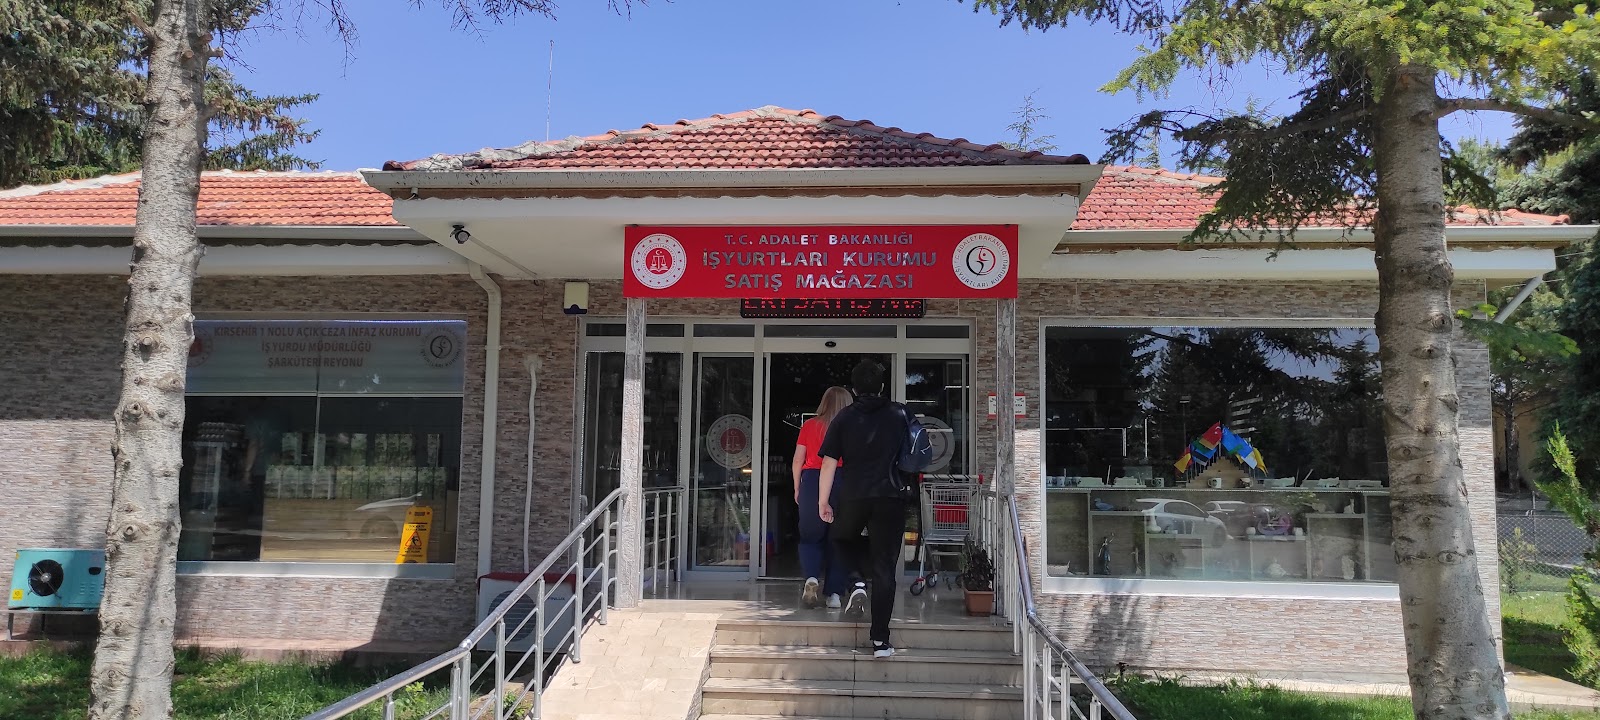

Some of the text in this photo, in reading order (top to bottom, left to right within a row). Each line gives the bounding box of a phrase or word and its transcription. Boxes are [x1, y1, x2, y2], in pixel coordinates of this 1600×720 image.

[759, 234, 818, 245] ADALET
[828, 232, 913, 245] BAKANLIĞI
[702, 248, 937, 269] İŞYURTLARI KURUMU
[724, 269, 913, 292] SATIŞ MAĞAZASI
[260, 327, 265, 337] 1
[267, 327, 294, 337] NOLU
[296, 327, 320, 338] AÇIK
[320, 327, 346, 337] CEZA
[348, 325, 377, 337] İNFAZ
[379, 327, 422, 337] KURUMU
[261, 340, 271, 353] İŞ
[272, 342, 306, 352] YURDU
[323, 357, 364, 367] REYONU
